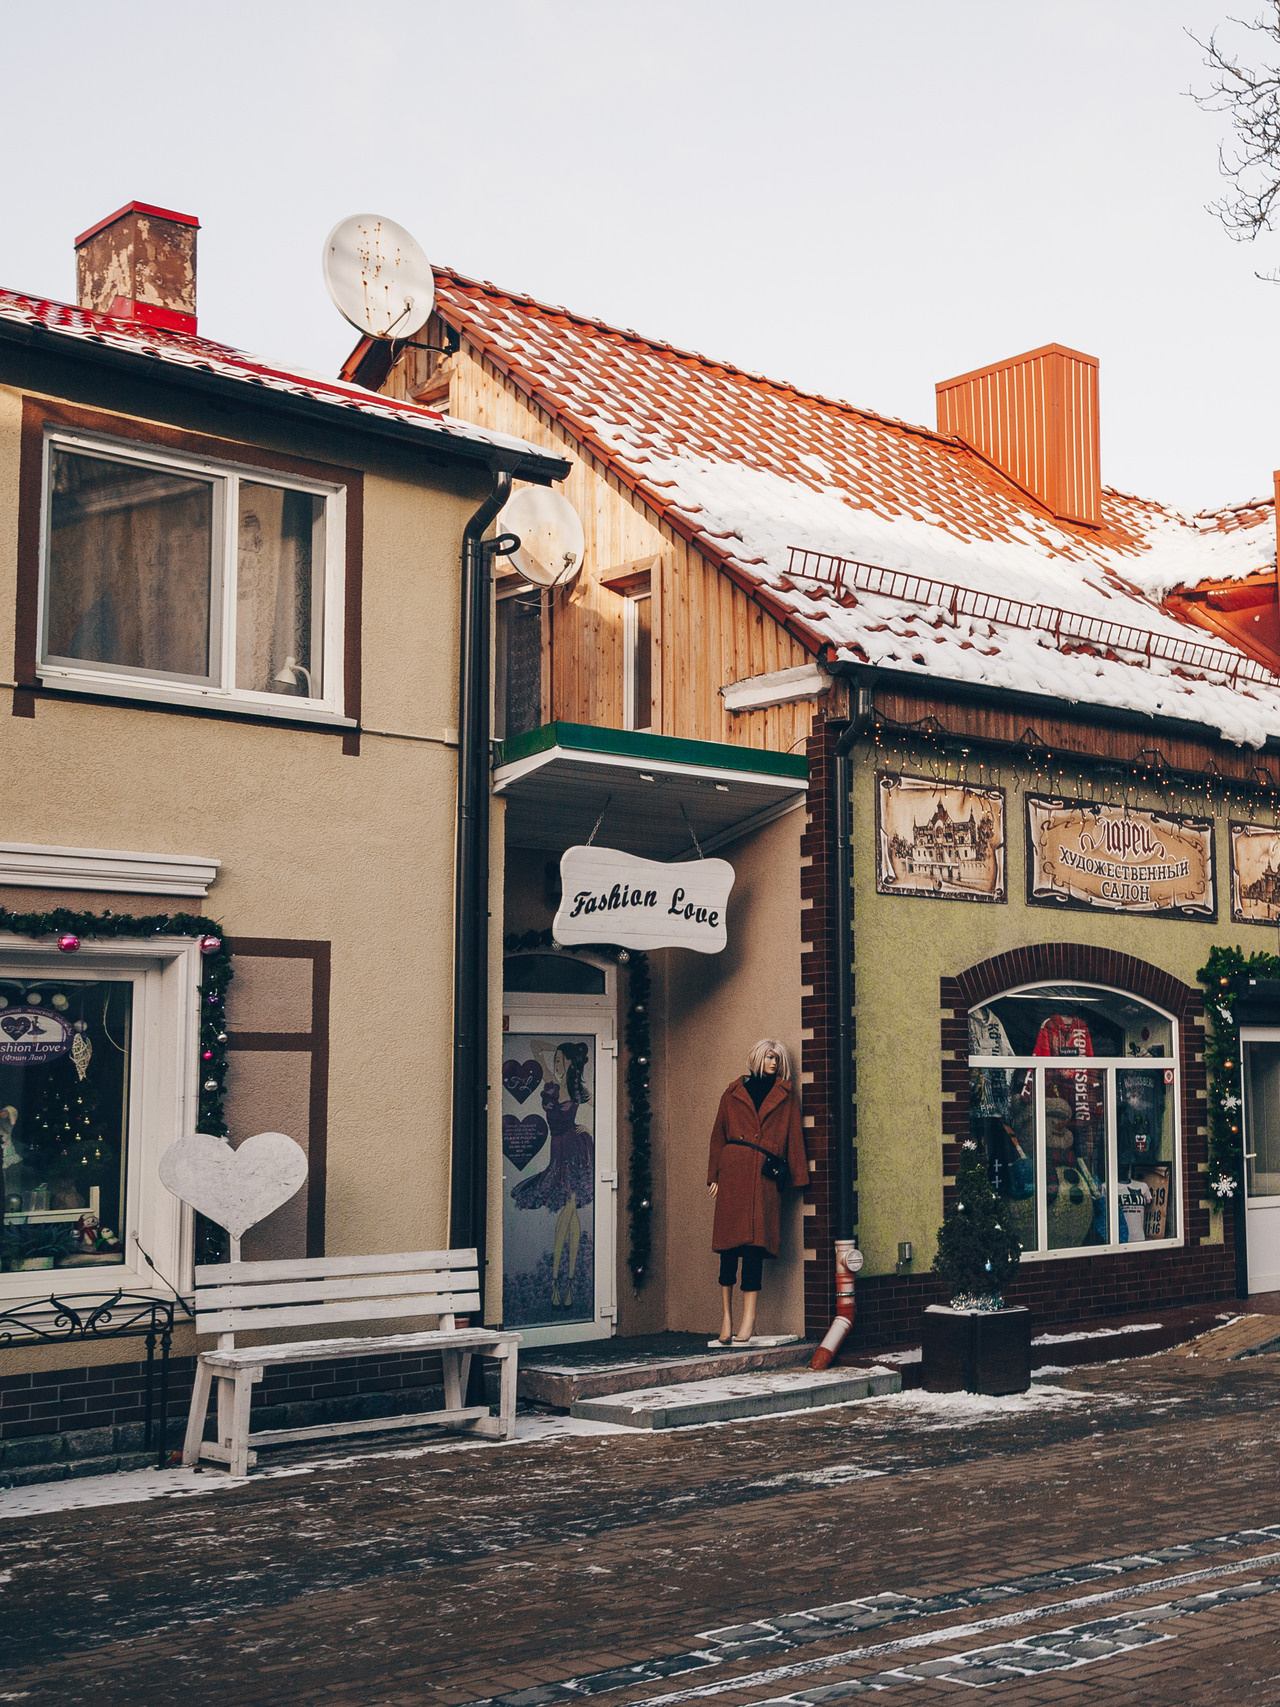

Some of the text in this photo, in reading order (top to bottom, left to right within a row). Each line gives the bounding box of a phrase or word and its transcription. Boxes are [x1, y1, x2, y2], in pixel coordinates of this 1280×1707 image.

[1060, 845, 1189, 882] ХУДОЖЕСТВЕННЫЙ
[1101, 881, 1150, 901] САЛОН
[569, 883, 720, 928] Fashion Love
[35, 1043, 61, 1053] Love
